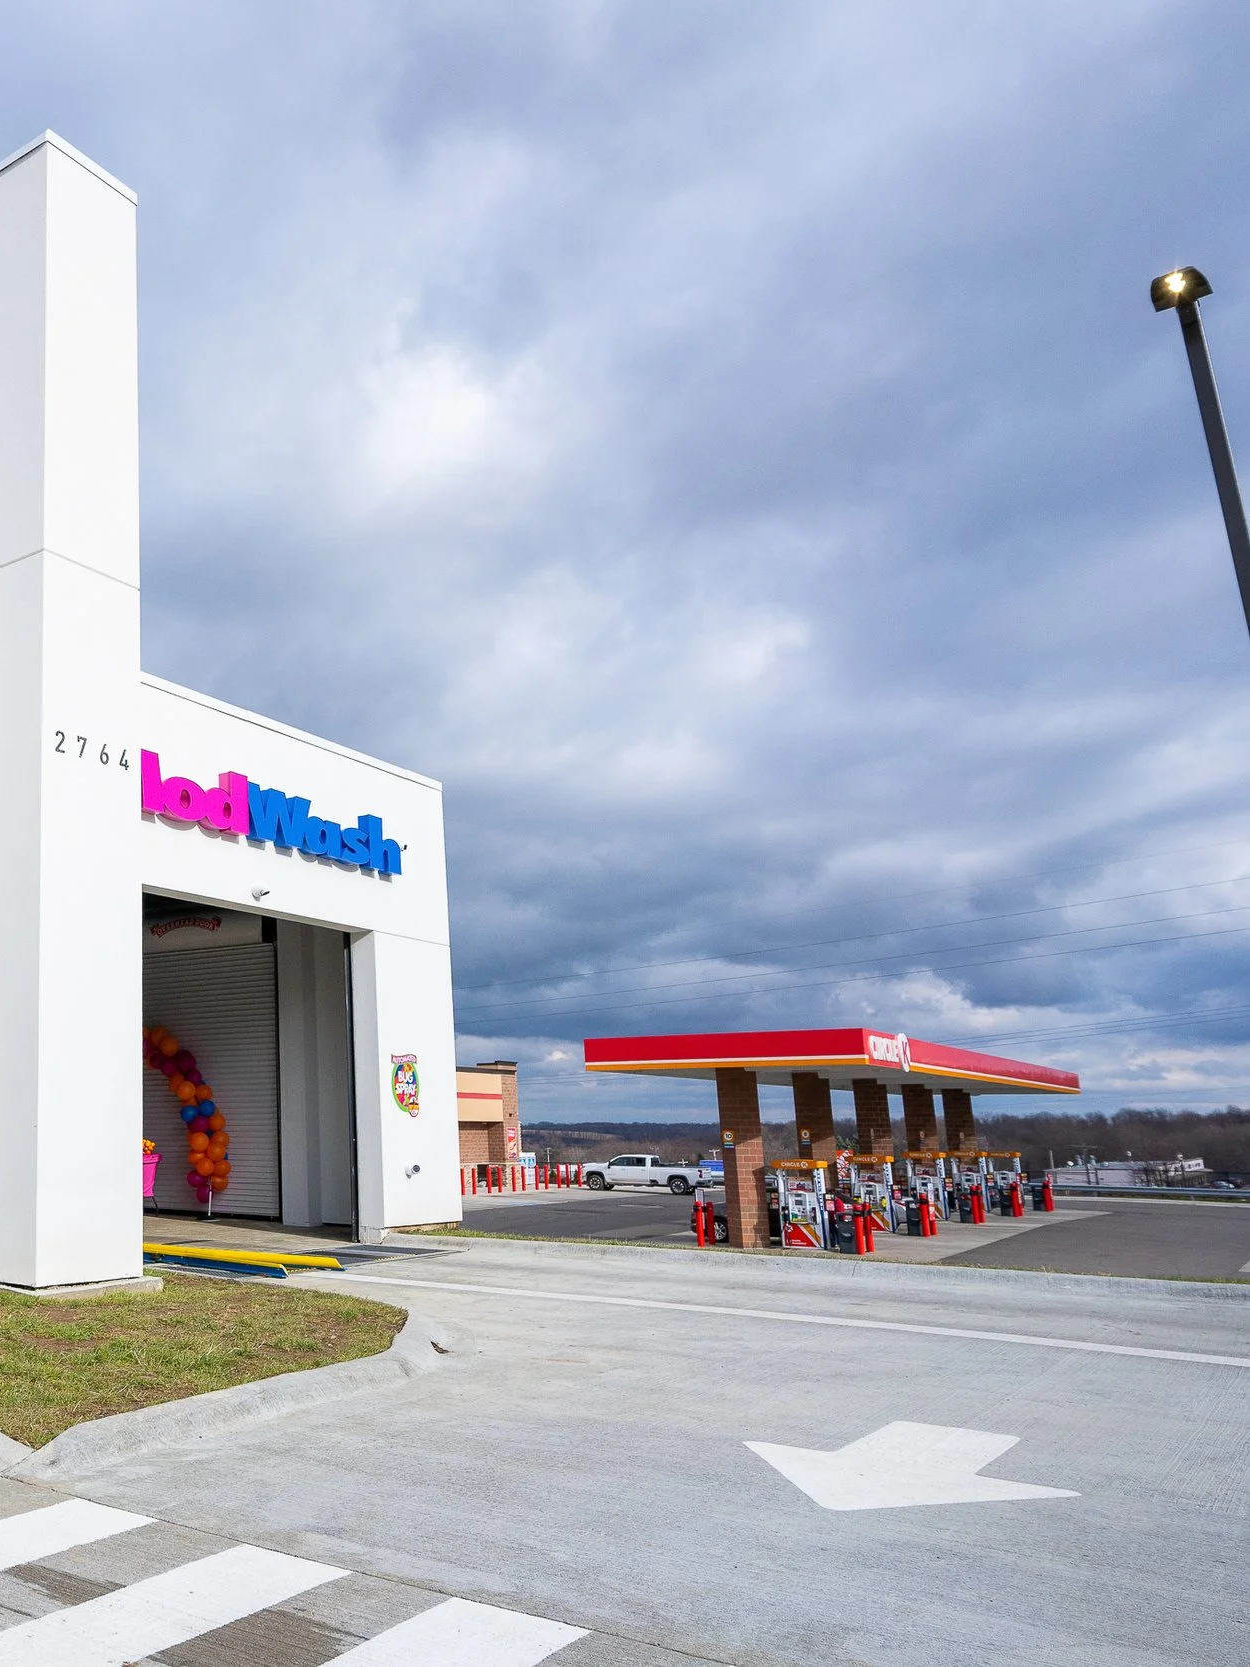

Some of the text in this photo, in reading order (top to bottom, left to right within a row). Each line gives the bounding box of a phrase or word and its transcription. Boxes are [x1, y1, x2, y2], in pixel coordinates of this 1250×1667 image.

[55, 730, 130, 771] 2764
[194, 919, 215, 931] DOOR
[901, 1040, 909, 1064] K
[397, 1070, 414, 1083] BUG
[395, 1083, 417, 1095] SPRAY
